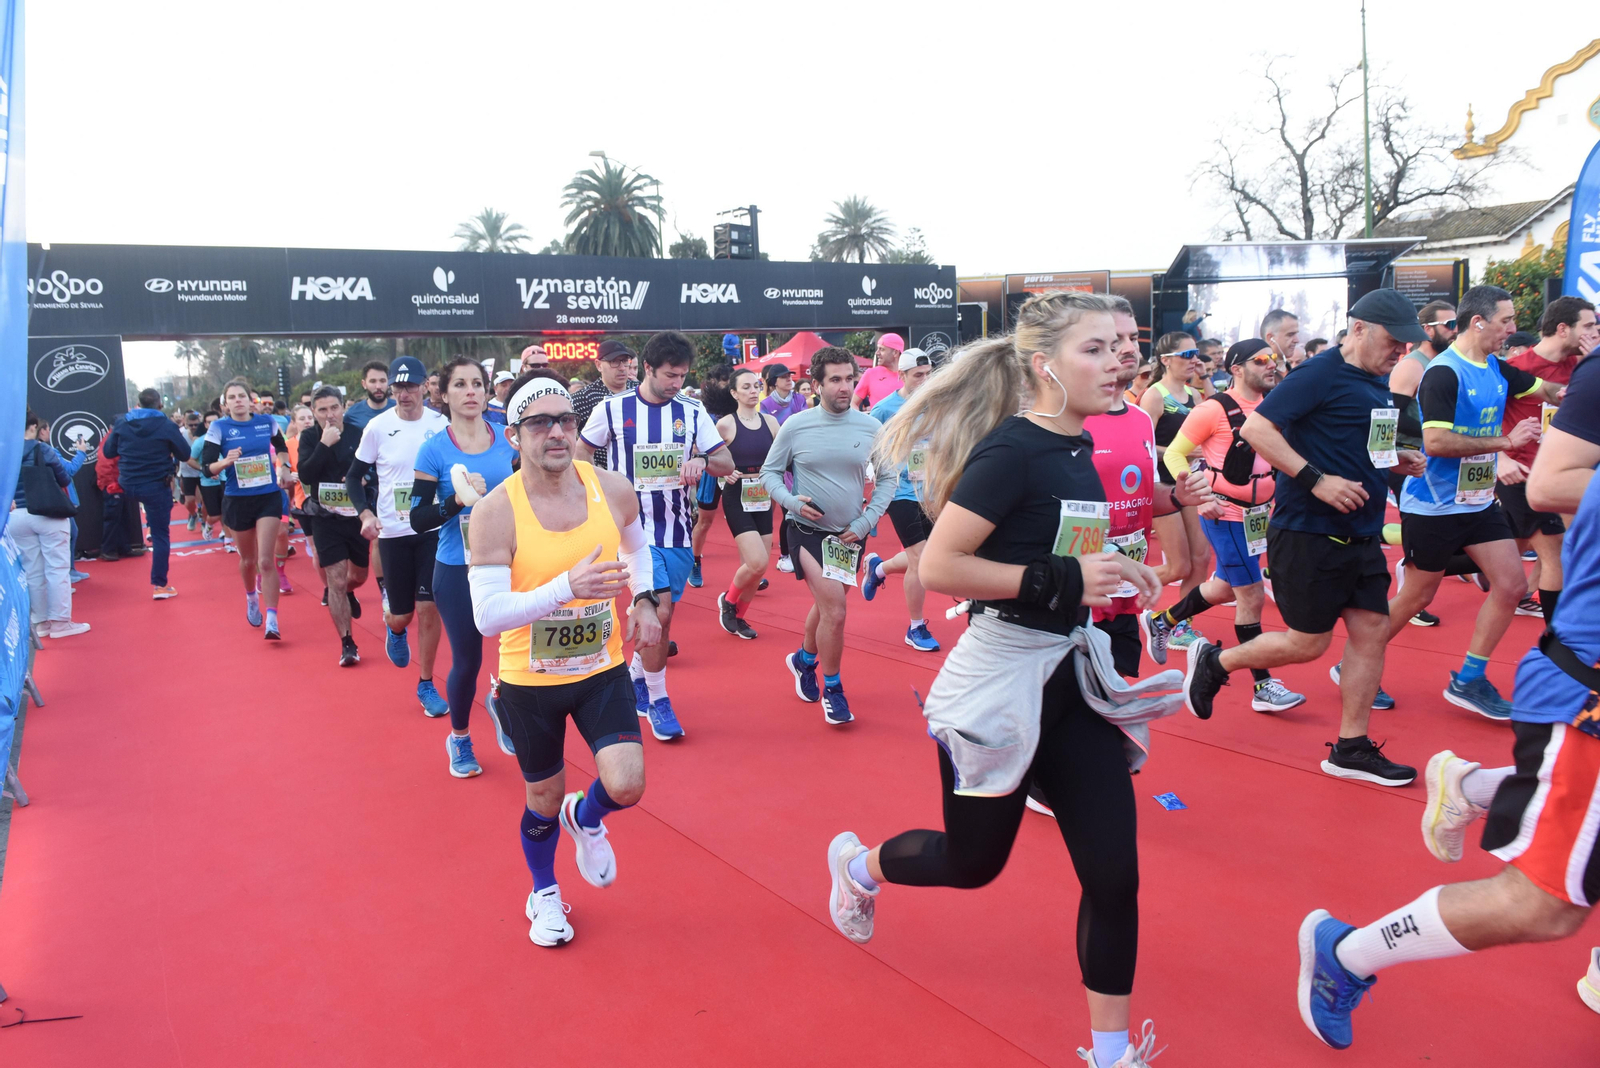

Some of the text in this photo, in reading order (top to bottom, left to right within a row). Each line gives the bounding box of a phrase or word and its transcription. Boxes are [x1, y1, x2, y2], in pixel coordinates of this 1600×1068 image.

[1582, 213, 1596, 242] FLY
[177, 280, 247, 291] HYUNDAI
[290, 276, 374, 301] HOKA
[542, 276, 631, 294] maratón
[680, 283, 739, 304] HOKA
[782, 289, 824, 298] HYUNDAI
[178, 293, 222, 302] Hyundauto
[567, 291, 632, 310] sevilla
[556, 315, 568, 323] 28
[597, 315, 619, 323] 2024
[543, 342, 600, 359] 00:02:5
[241, 463, 264, 475] 7299
[642, 454, 674, 469] 9040
[827, 545, 849, 564] 9039
[584, 602, 604, 617] SEVILLA
[544, 622, 597, 647] 7883
[1381, 914, 1420, 950] trail
